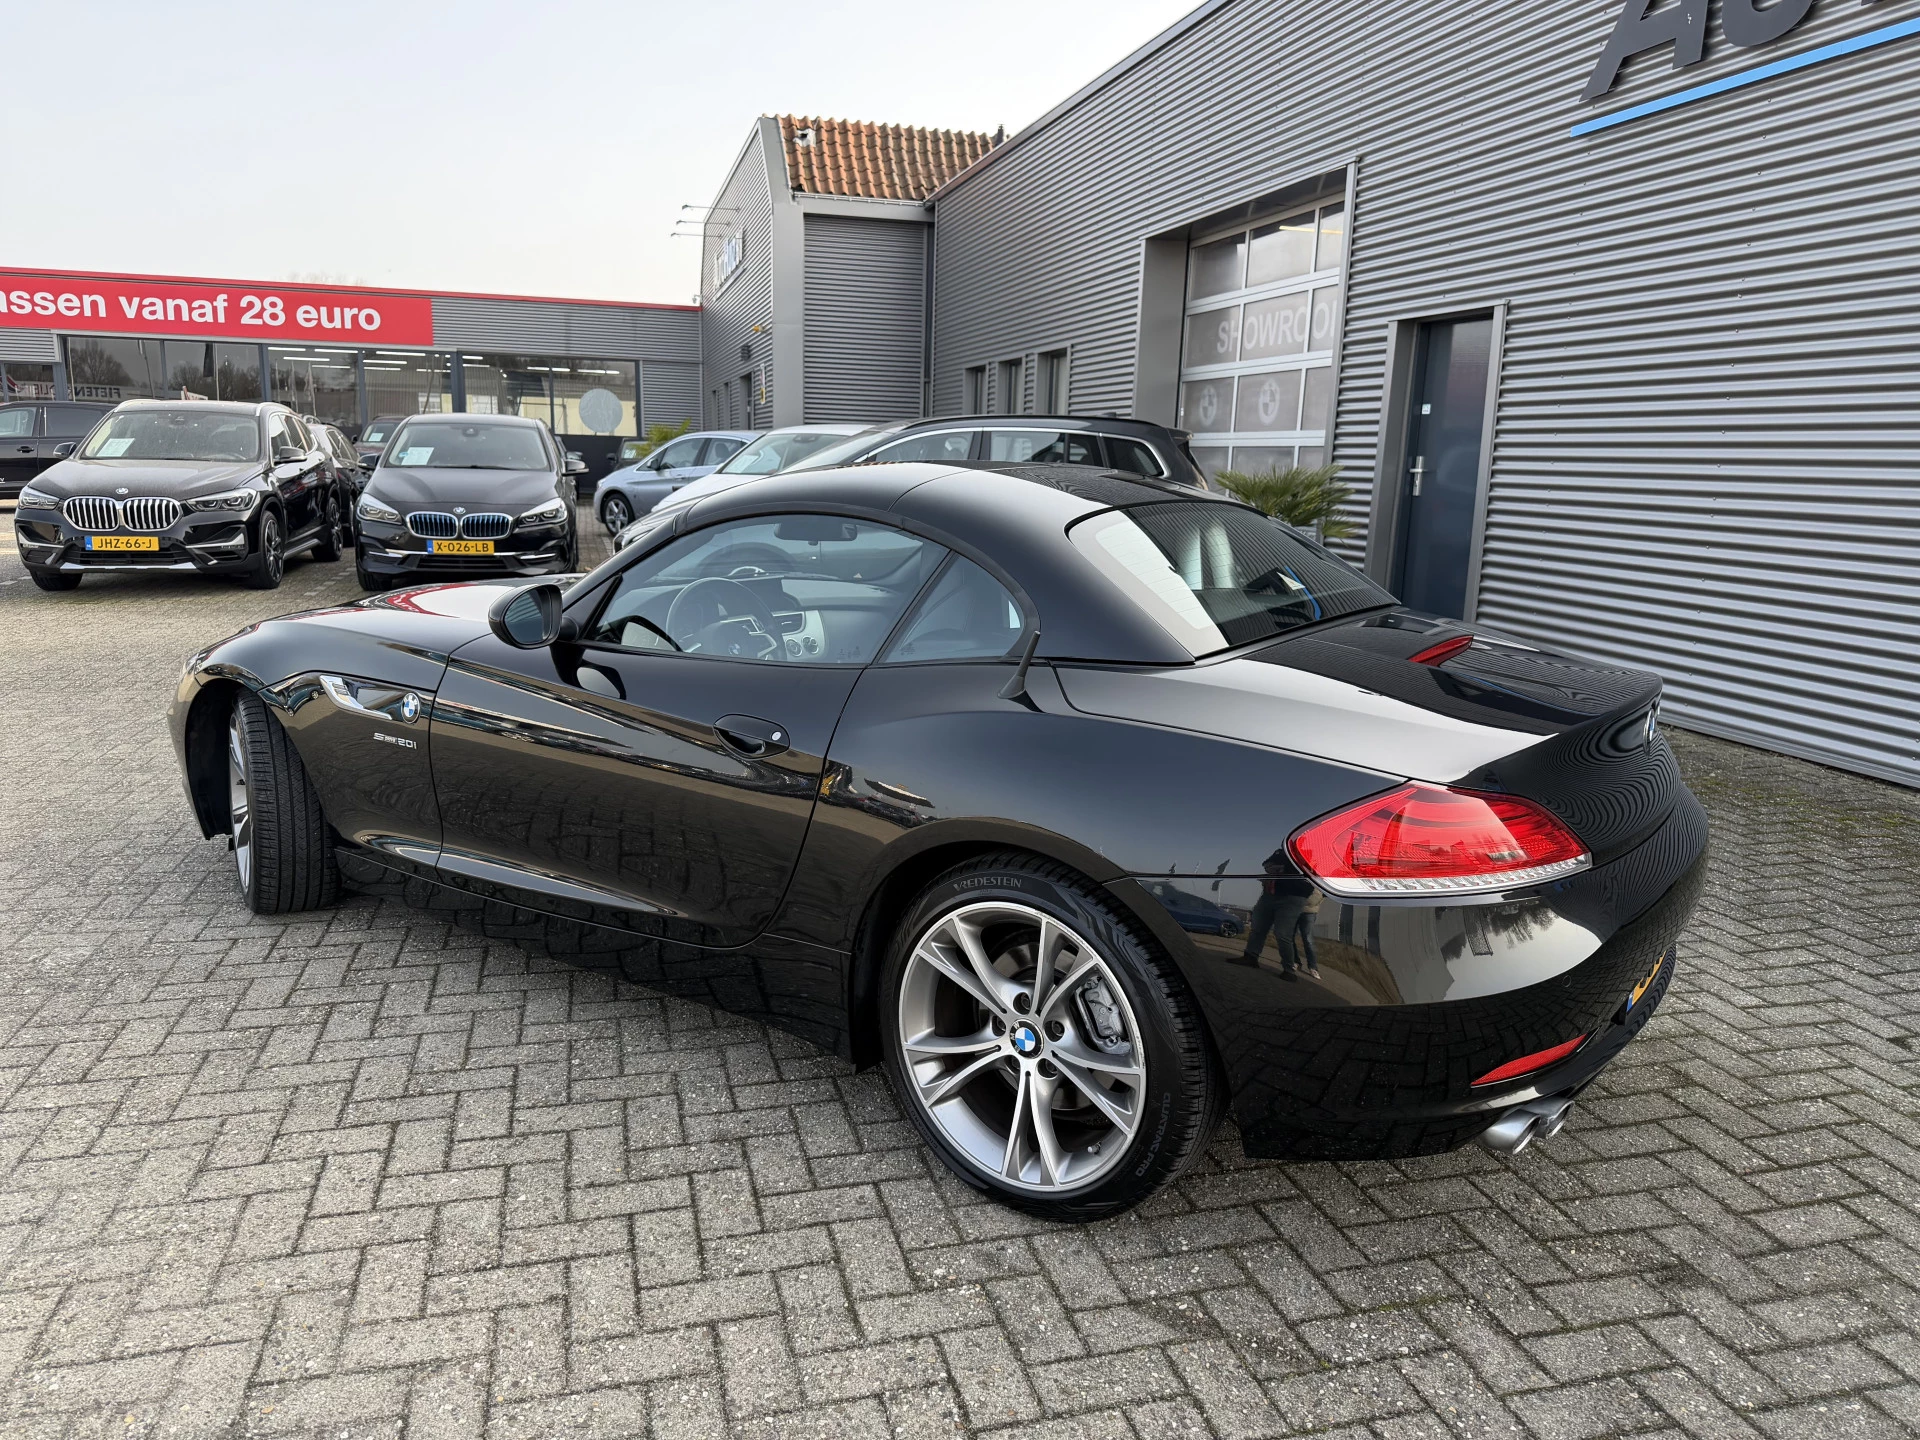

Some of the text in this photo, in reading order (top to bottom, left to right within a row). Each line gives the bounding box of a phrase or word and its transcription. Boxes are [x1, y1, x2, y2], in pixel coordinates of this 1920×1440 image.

[118, 294, 228, 323] vanaf
[240, 295, 286, 326] 28
[296, 305, 381, 331] euro
[98, 538, 152, 549] JHZ-66-J
[436, 542, 489, 552] X-026-LB
[953, 876, 1022, 891] VREDESTEIN
[1135, 1092, 1171, 1177] QUATRAC PRO
